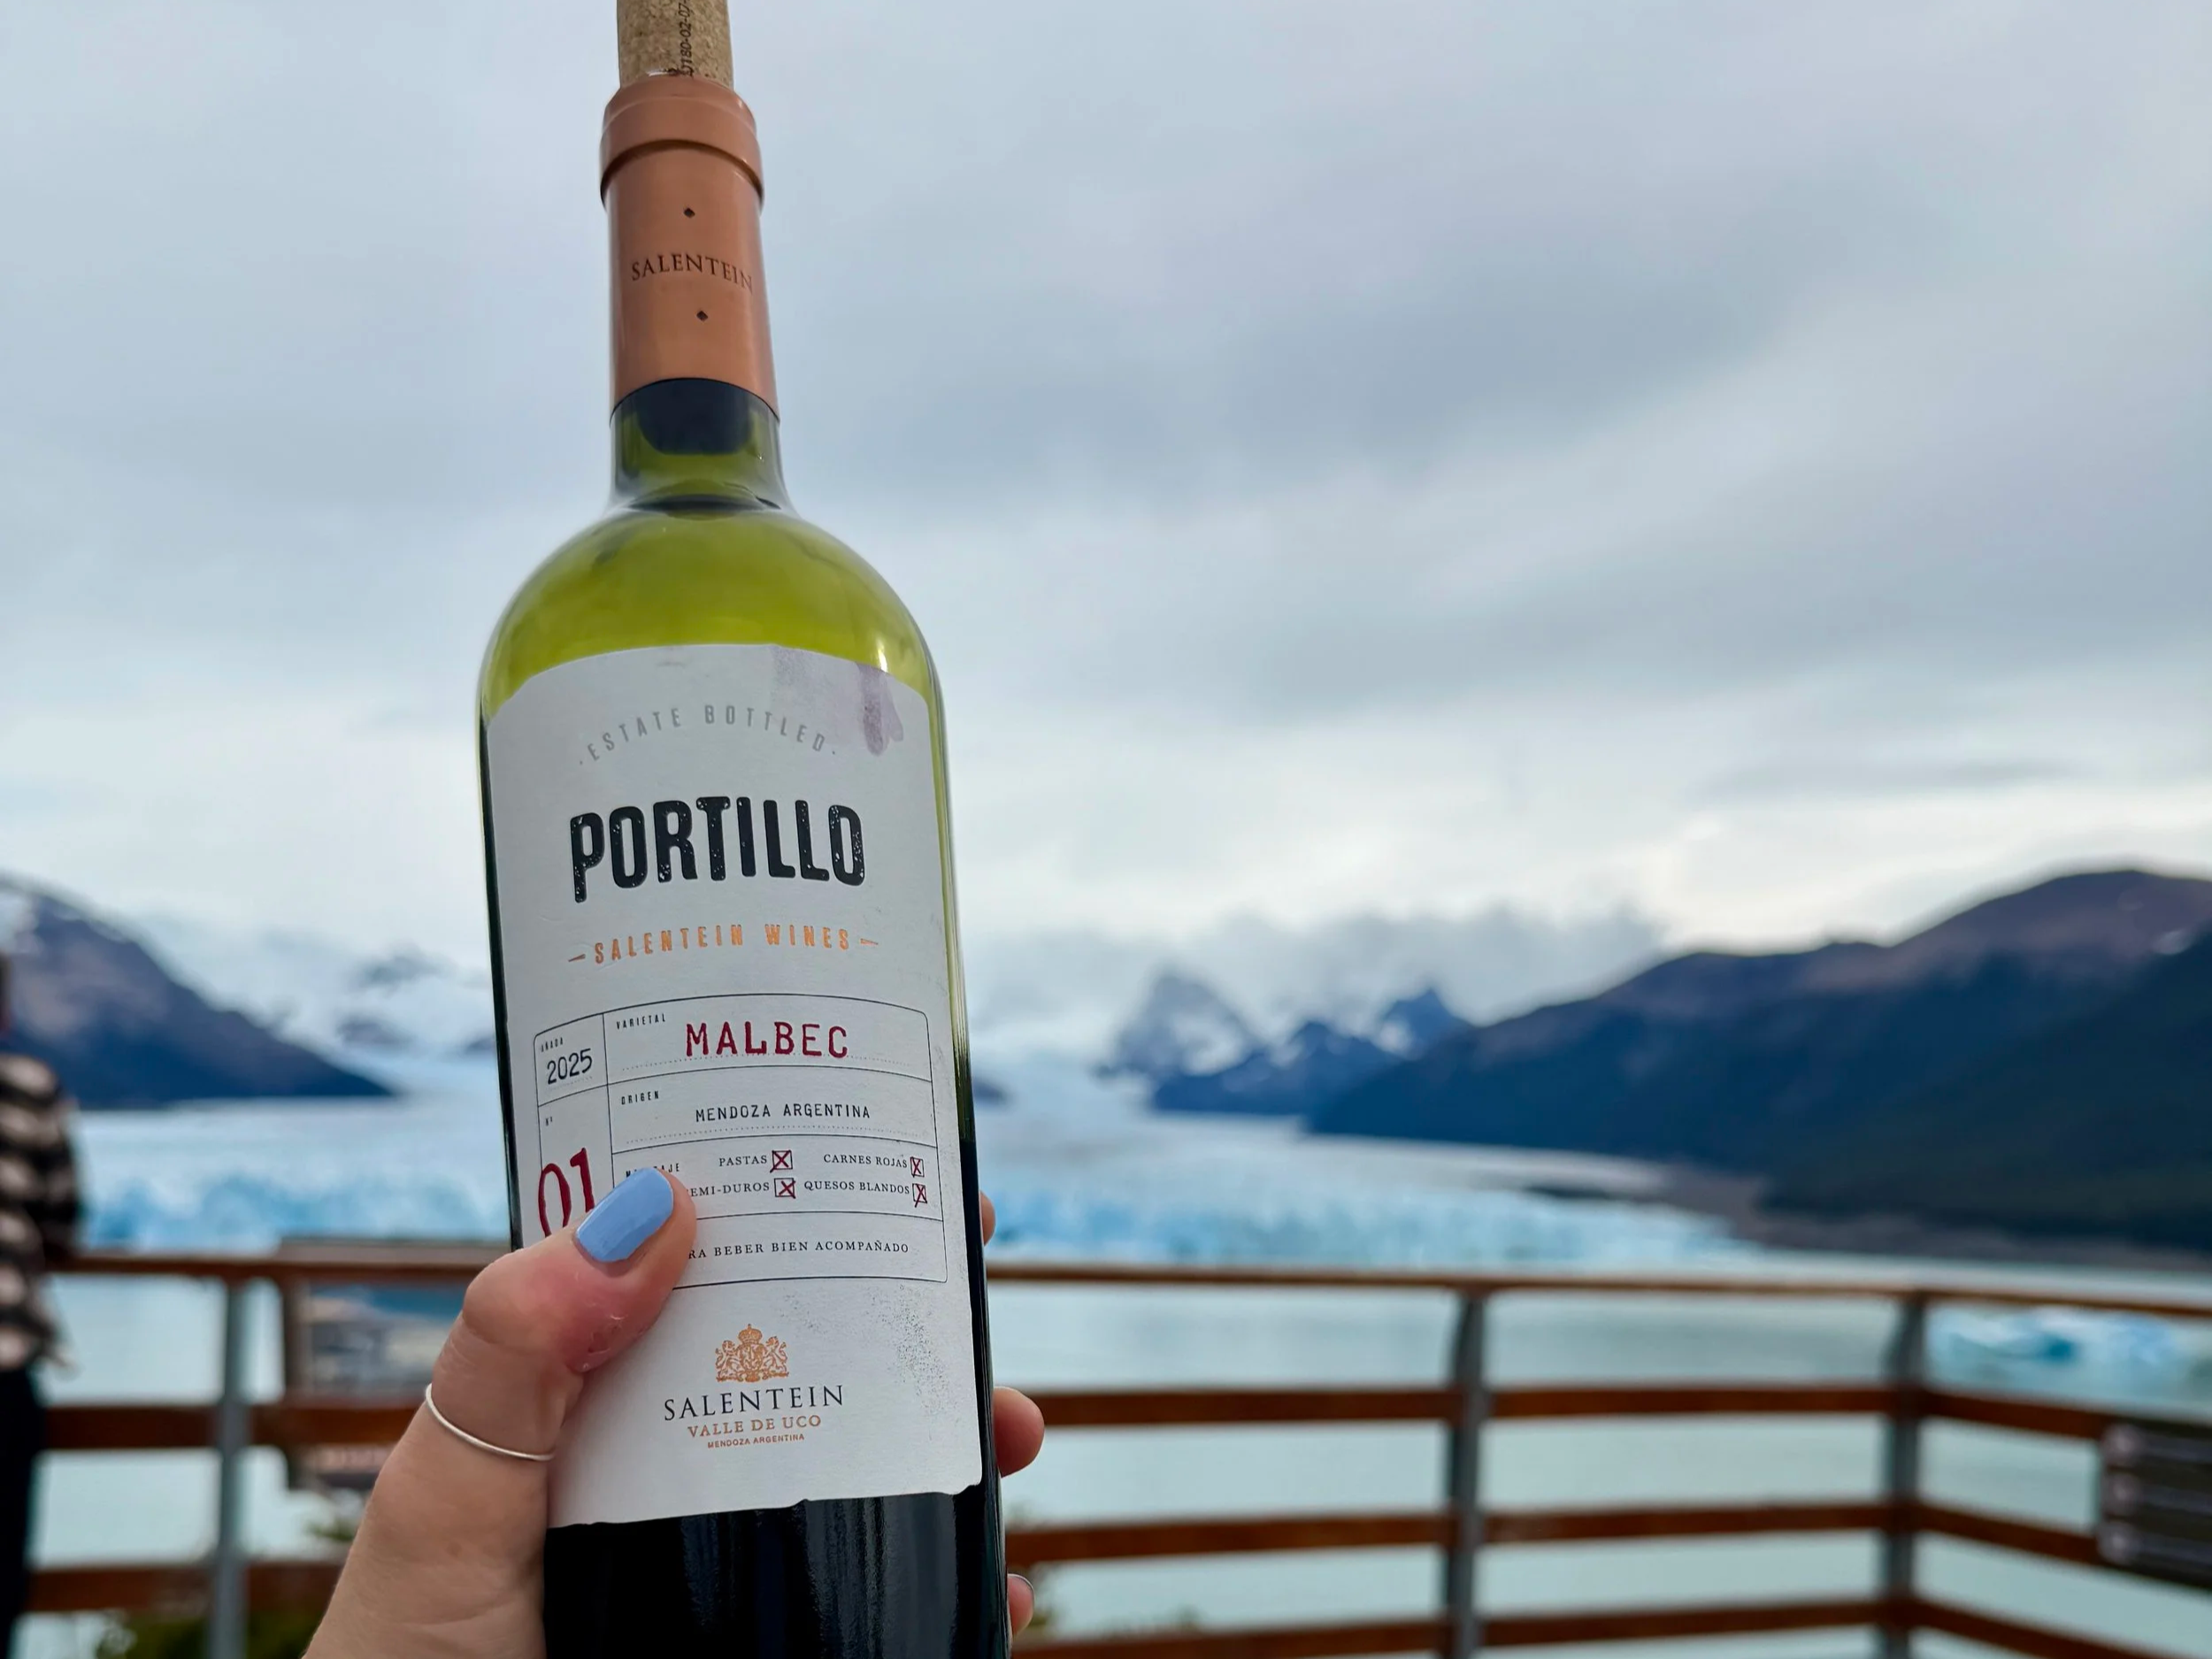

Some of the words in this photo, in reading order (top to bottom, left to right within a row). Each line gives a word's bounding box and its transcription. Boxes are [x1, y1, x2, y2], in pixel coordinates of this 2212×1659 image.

[631, 252, 752, 295] SALENTEIN
[587, 708, 681, 761] ESTATE
[704, 704, 825, 751] BOTTLED
[570, 795, 865, 903] PORTILLO
[594, 925, 743, 964] SALENTEIN
[764, 924, 849, 950] WINES
[616, 1013, 666, 1030] VARIETAL
[686, 1020, 848, 1058] MALBEC
[547, 1048, 593, 1085] 2025
[621, 1090, 659, 1105] ORIGEN
[695, 1104, 771, 1122] MENDOZA
[783, 1103, 871, 1118] ARGENTINA
[718, 1155, 767, 1167] PASTAS
[823, 1154, 872, 1165] CARNES
[876, 1156, 908, 1168] ROJAS
[538, 1147, 595, 1238] 01
[687, 1181, 770, 1197] EMI-DUROS
[803, 1180, 855, 1191] QUESOS
[859, 1181, 910, 1194] BLANDOS
[688, 1248, 707, 1259] RA
[714, 1243, 764, 1256] BEBER
[772, 1240, 809, 1253] BIEN
[815, 1240, 909, 1253] ACOMPAÑADO
[664, 1385, 843, 1421] SALENTEIN
[687, 1421, 744, 1438] VALLE
[751, 1418, 775, 1432] DE
[782, 1415, 821, 1429] UCO
[708, 1437, 750, 1448] MENDOZA
[753, 1433, 805, 1444] ARGENTINA
